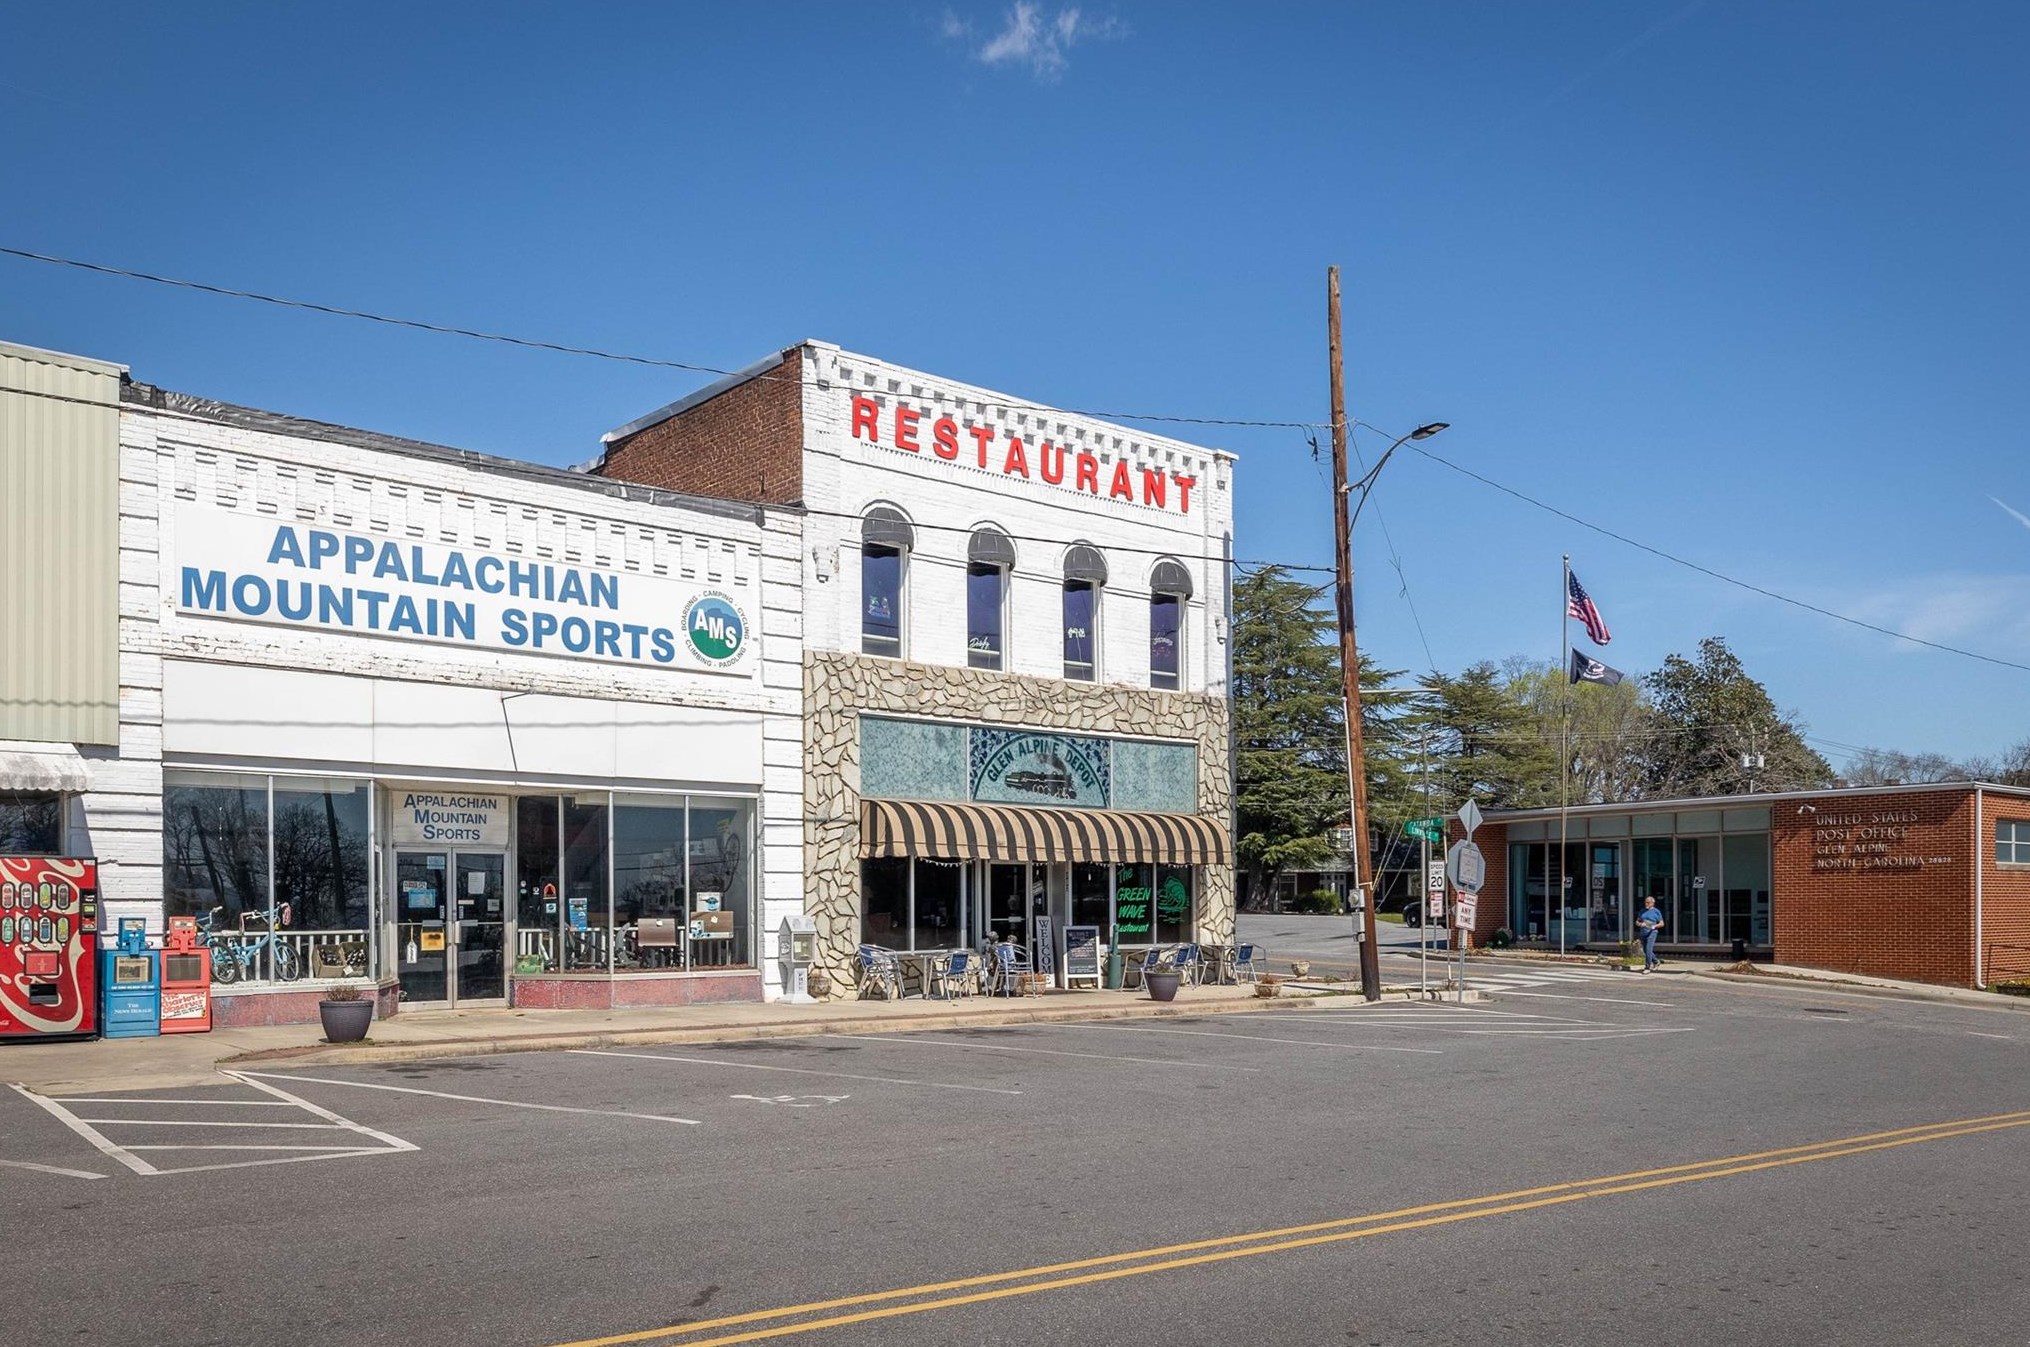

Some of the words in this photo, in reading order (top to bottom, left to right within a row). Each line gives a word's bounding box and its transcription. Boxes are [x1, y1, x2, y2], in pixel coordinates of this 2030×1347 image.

[851, 395, 1196, 514] RESTAURANT
[267, 525, 619, 610] APPALACHIAN
[702, 590, 734, 604] CAMPING
[181, 566, 476, 640] MOUNTAIN
[500, 607, 675, 663] SPORTS
[680, 595, 698, 631] BOARDING
[694, 608, 738, 649] AMS
[737, 607, 750, 640] CYCLING
[685, 639, 712, 667] CLIMBING
[718, 646, 747, 668] PADDLING
[987, 749, 1015, 782] GLEN
[1018, 739, 1060, 757] ALPINE
[1065, 749, 1096, 789] DEPOT
[404, 793, 497, 809] APPALACHIAN
[414, 809, 487, 824] MOUNTAIN
[1816, 813, 1862, 826] UNITED
[1871, 810, 1918, 823] STATES
[423, 824, 481, 840] SPORTS
[1816, 828, 1851, 841] POST
[1860, 826, 1909, 839] OFFICE
[1817, 844, 1845, 855] GLEN
[1854, 842, 1892, 853] ALPINE
[1817, 858, 1856, 868] NORTH
[1864, 856, 1925, 868] CAROLINA
[1116, 866, 1134, 883] The
[1430, 876, 1443, 887] 20
[1116, 887, 1152, 901] GREEN
[1118, 904, 1147, 919] WAVE
[1461, 907, 1472, 915] ANY
[1117, 922, 1150, 933] estaurant
[1460, 915, 1472, 925] TIME
[1038, 919, 1052, 985] WELCOME
